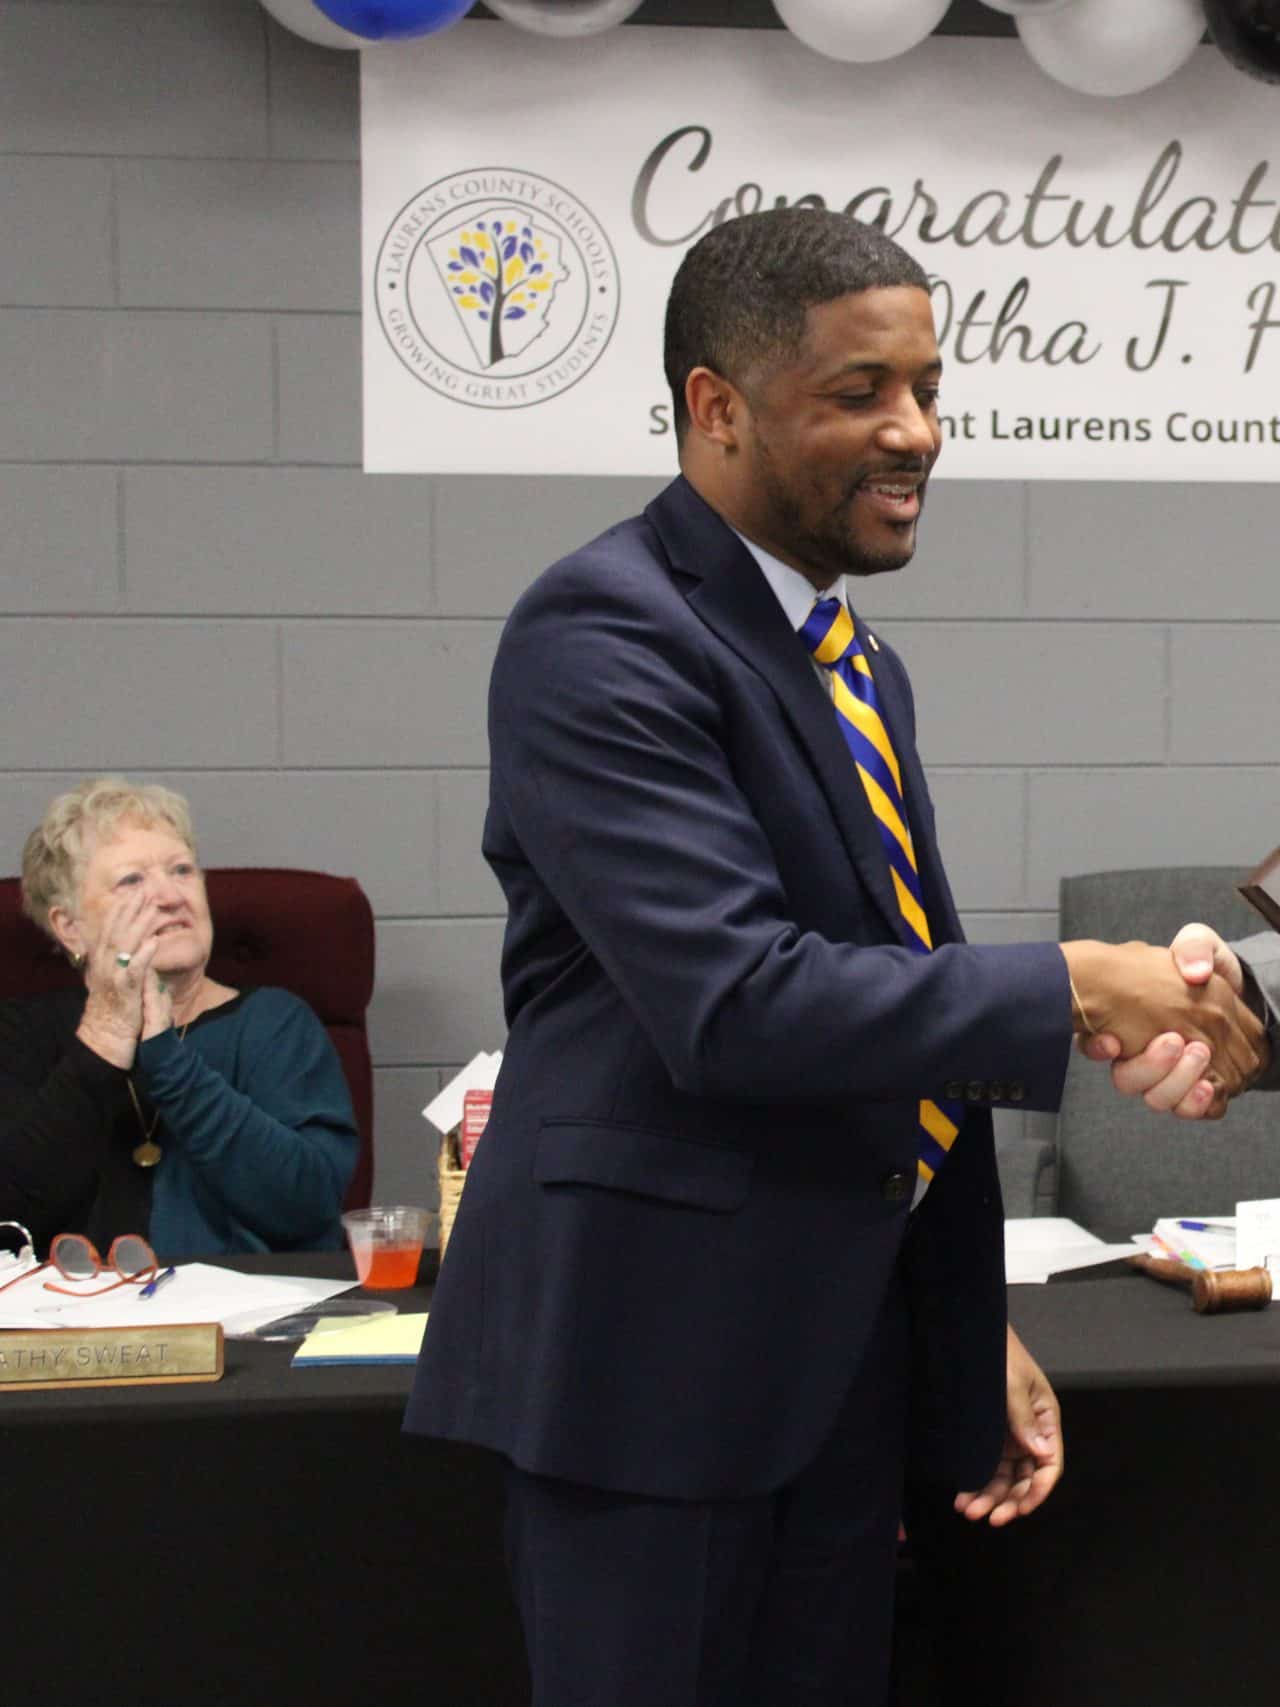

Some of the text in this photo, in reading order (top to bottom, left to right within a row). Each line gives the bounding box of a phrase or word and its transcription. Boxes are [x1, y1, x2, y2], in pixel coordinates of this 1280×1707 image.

[386, 176, 608, 283] LAURENS COUNTY SCHOOLS
[388, 307, 609, 401] GROWING GREAT STUDENTS
[1125, 279, 1193, 372] J.
[991, 409, 1152, 442] Laurens
[76, 1343, 169, 1367] SWEAT
